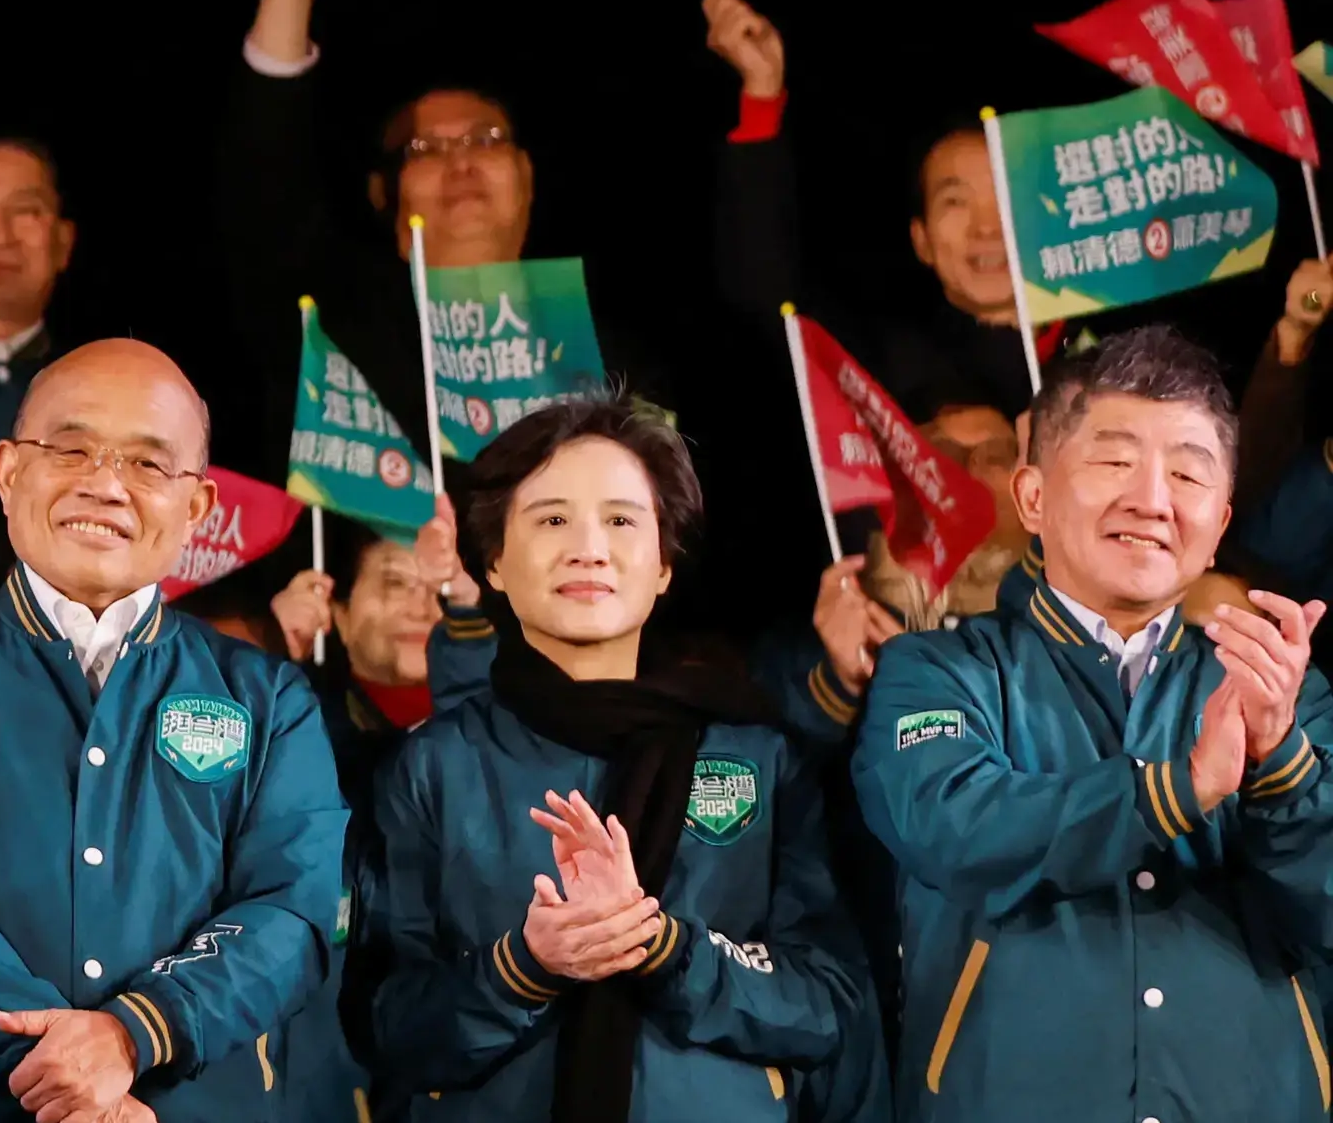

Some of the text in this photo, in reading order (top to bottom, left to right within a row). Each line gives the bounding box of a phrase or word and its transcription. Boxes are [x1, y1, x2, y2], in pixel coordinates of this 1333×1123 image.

[1054, 115, 1205, 187] 選對的人
[1064, 153, 1225, 229] 走對的路!
[181, 735, 224, 756] 2024
[696, 799, 738, 818] 2024
